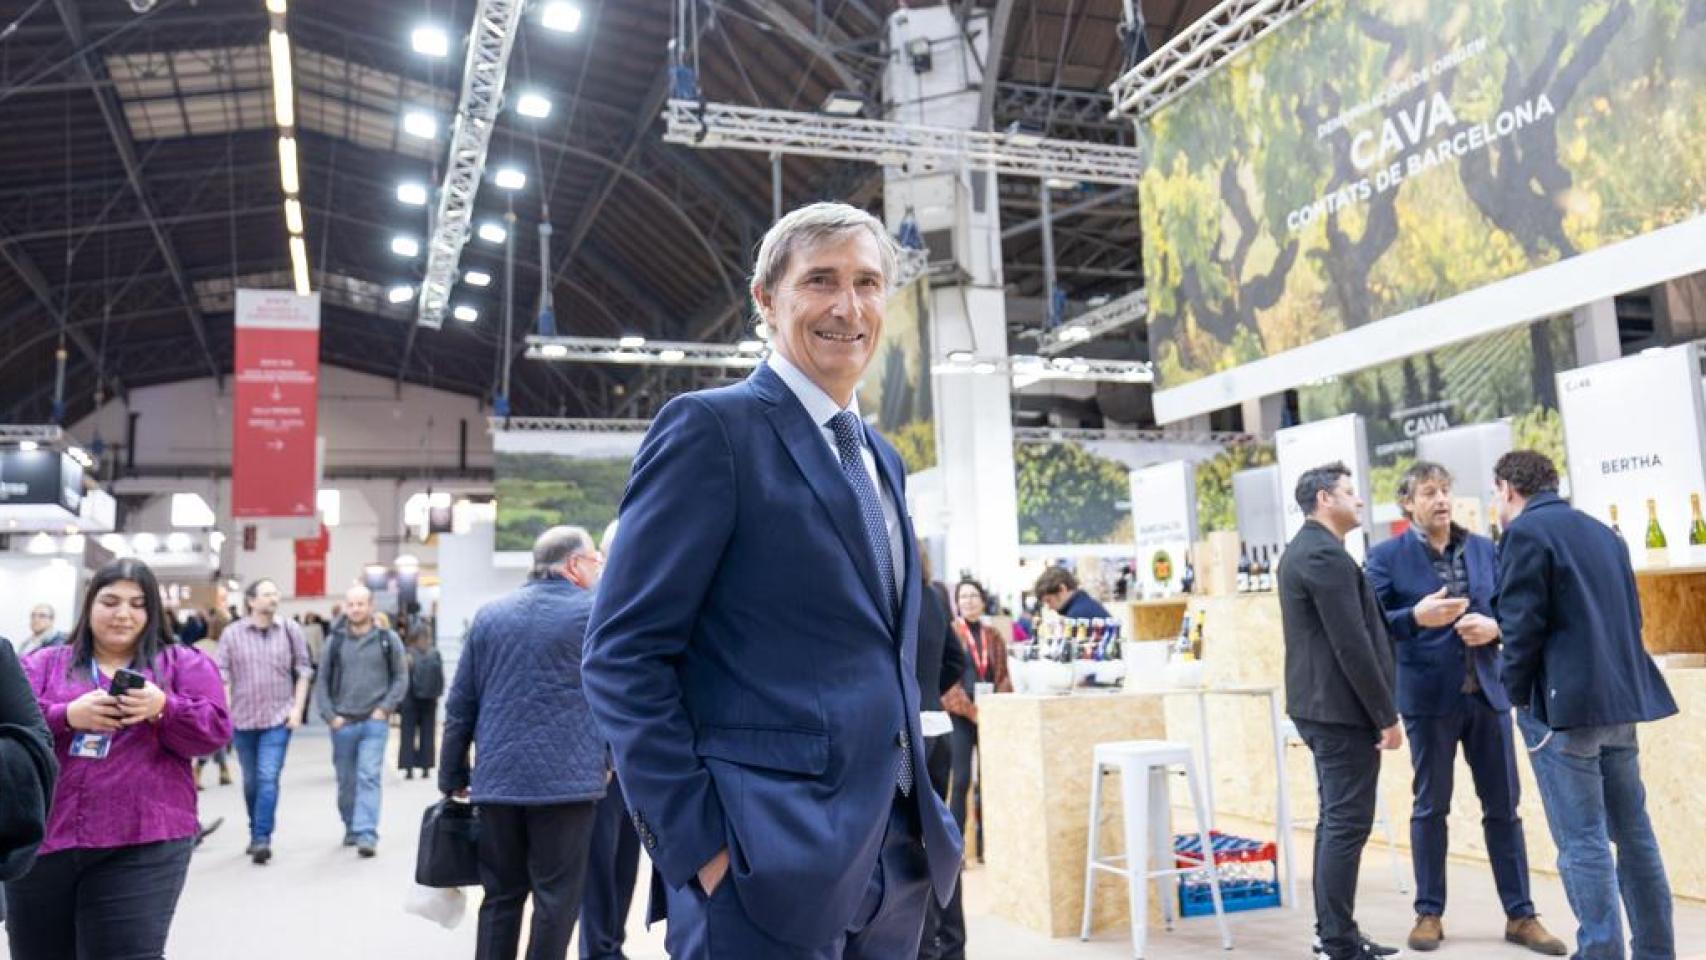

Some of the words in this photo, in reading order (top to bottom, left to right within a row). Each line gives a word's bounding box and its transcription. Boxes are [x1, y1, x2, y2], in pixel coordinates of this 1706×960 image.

[1351, 91, 1457, 169] CAVA
[1376, 162, 1403, 192] DE
[1406, 94, 1555, 177] BARCELONA
[1404, 413, 1449, 438] CAVA
[1601, 454, 1662, 474] BERTHA
